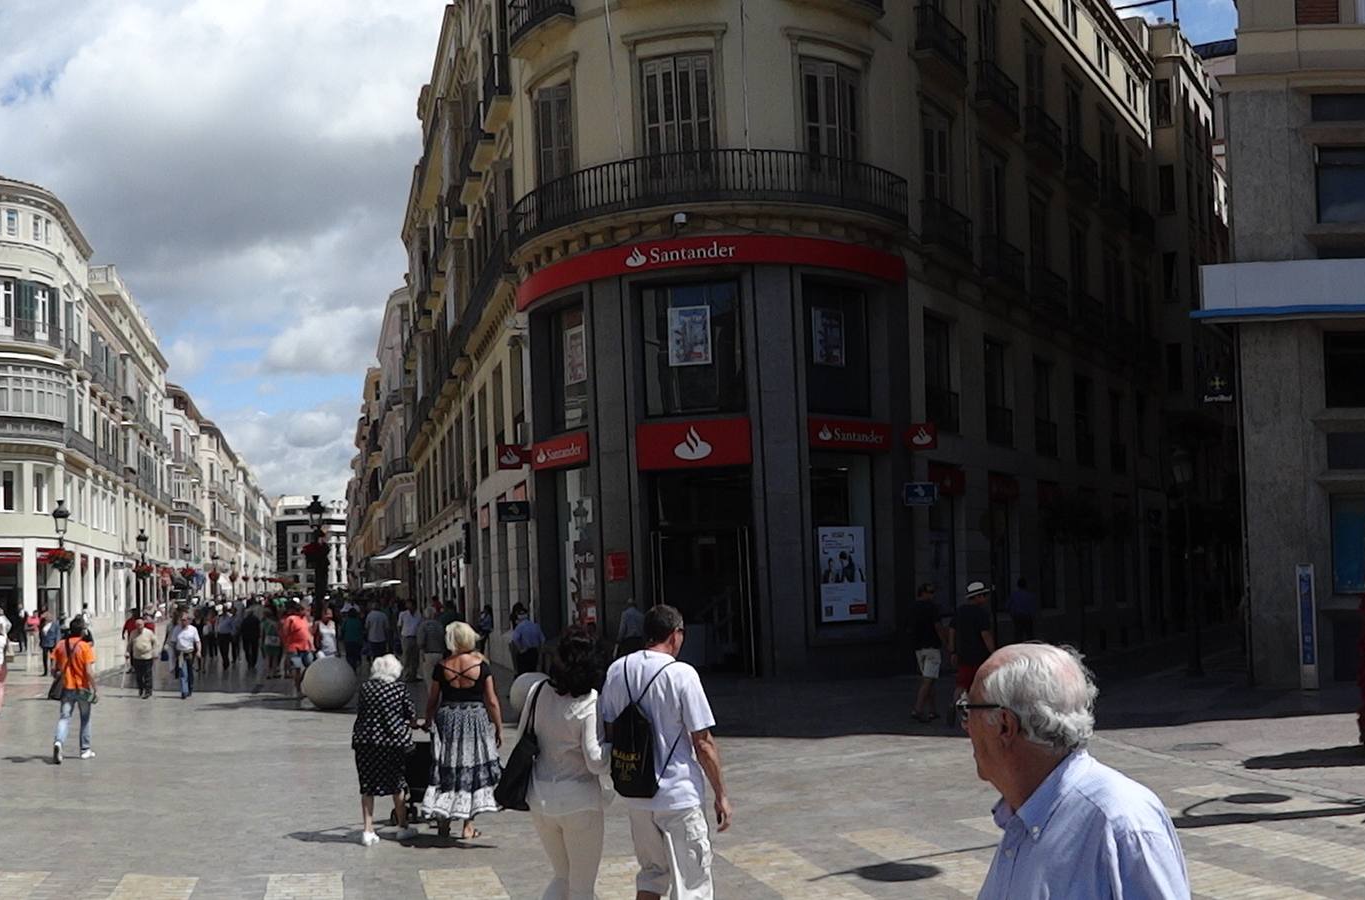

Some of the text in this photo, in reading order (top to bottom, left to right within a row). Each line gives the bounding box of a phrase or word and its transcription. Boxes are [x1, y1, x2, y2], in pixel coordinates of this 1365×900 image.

[650, 241, 736, 264] Santander
[833, 427, 885, 444] Santander
[546, 443, 582, 462] Santander
